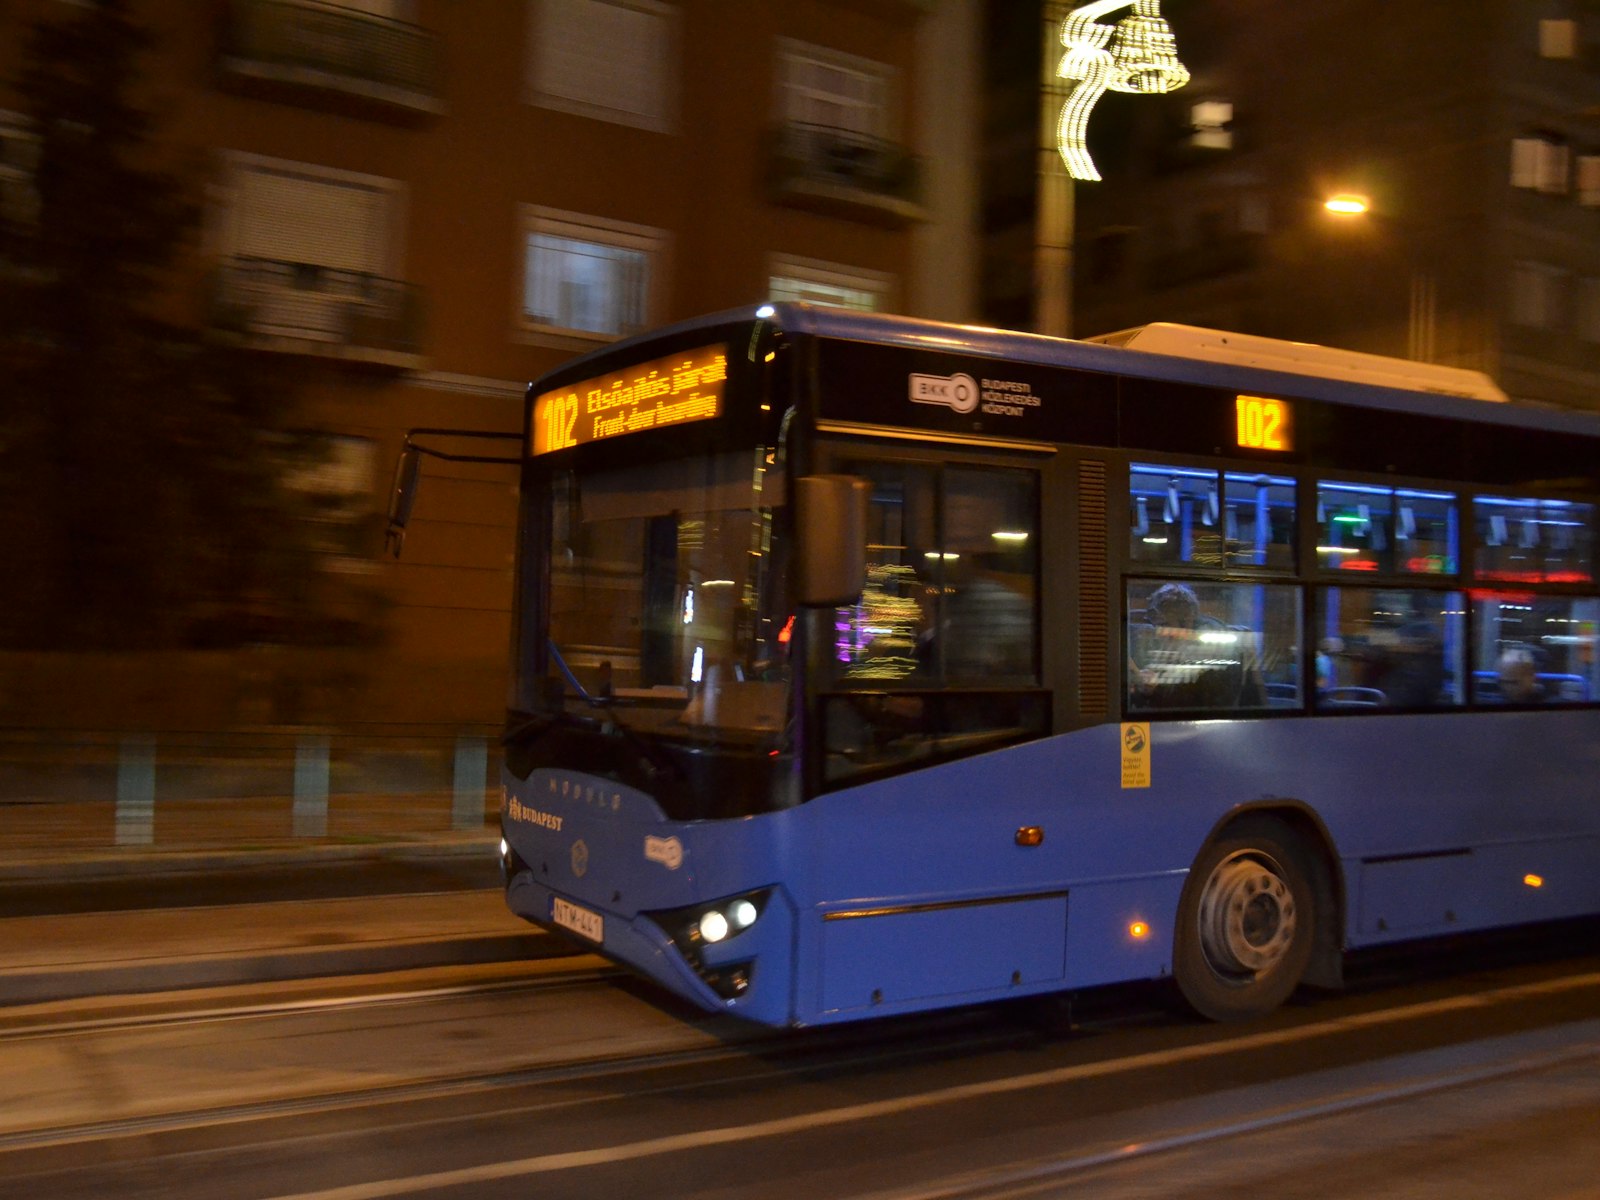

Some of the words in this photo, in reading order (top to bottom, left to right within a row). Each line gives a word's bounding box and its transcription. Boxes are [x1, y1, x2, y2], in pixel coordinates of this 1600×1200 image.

[543, 393, 579, 452] 102
[1236, 399, 1281, 449] 102
[522, 805, 563, 832] BUDAPEST
